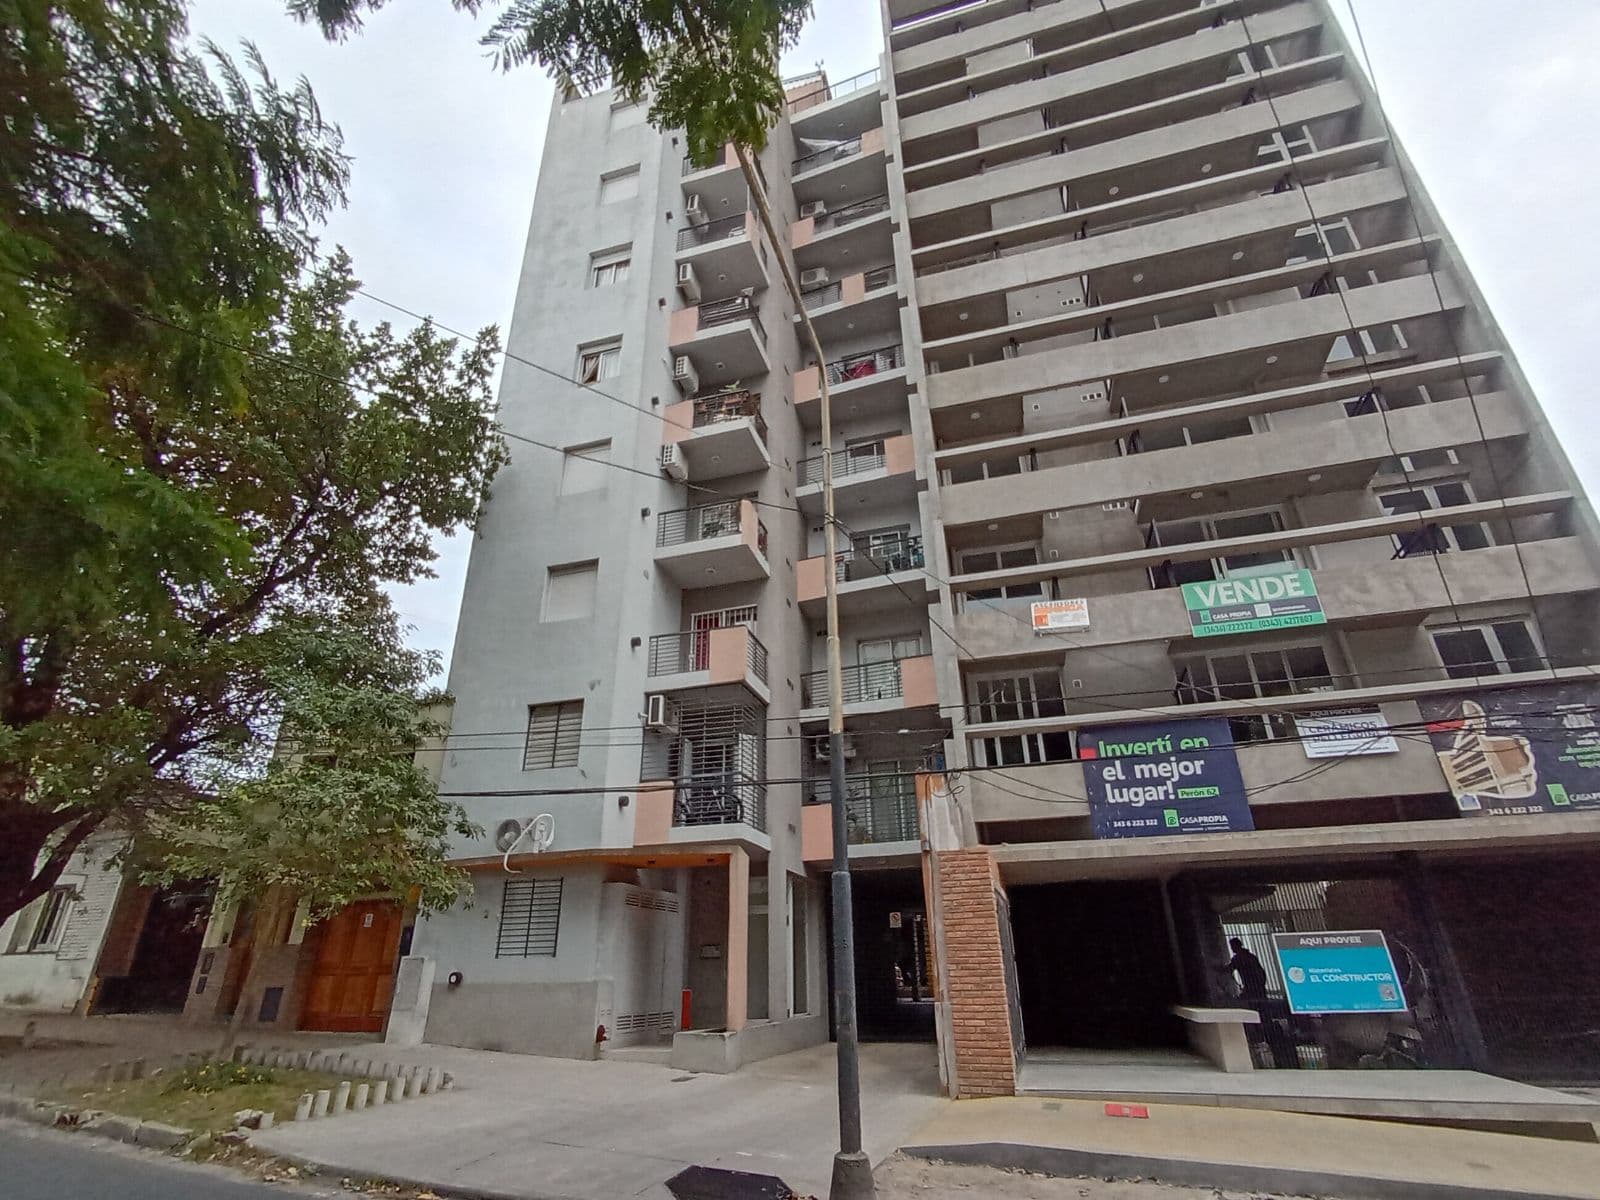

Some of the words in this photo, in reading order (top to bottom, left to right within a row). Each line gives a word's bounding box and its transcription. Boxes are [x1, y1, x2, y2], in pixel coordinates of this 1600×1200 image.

[1193, 573, 1304, 607] VENDE
[1098, 734, 1173, 758] Invertí
[1180, 736, 1209, 750] en
[1102, 760, 1126, 781] el
[1134, 756, 1205, 782] mejor
[1105, 780, 1176, 807] lugar!
[1300, 937, 1322, 946] AQUI
[1324, 936, 1361, 945] PROVEE
[1310, 974, 1321, 983] EL
[1322, 973, 1393, 982] CONSTRUCTOR
